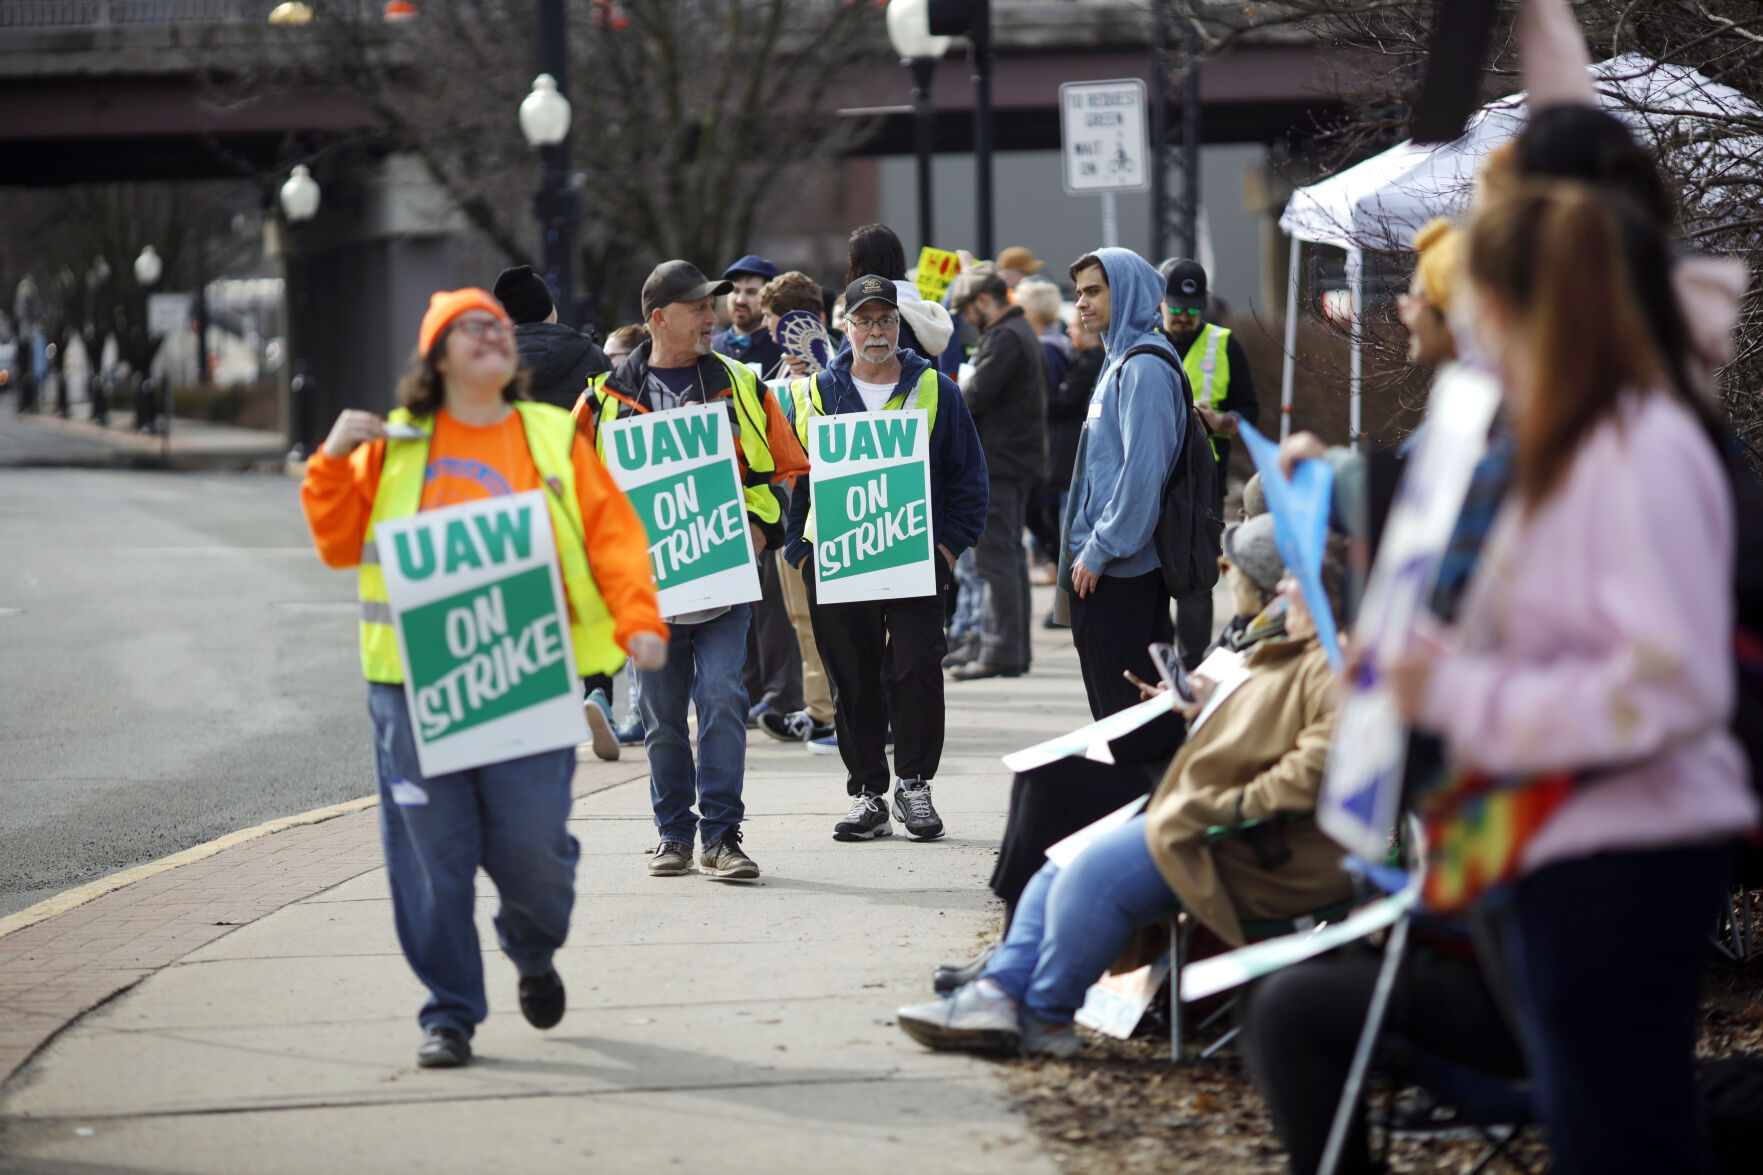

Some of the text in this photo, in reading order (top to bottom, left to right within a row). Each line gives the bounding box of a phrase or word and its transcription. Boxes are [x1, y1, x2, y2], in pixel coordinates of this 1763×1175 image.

[1074, 140, 1102, 155] WAIT
[1085, 111, 1124, 127] GREEN
[1080, 160, 1097, 175] ON
[613, 412, 719, 471] UAW
[818, 418, 919, 463] UAW
[653, 475, 699, 530] ON
[846, 473, 888, 522] ON
[393, 506, 531, 582] UAW
[646, 499, 744, 584] TRIKE
[819, 499, 927, 577] STRIKE
[445, 585, 509, 658] ON
[416, 612, 564, 739] STRIKE
